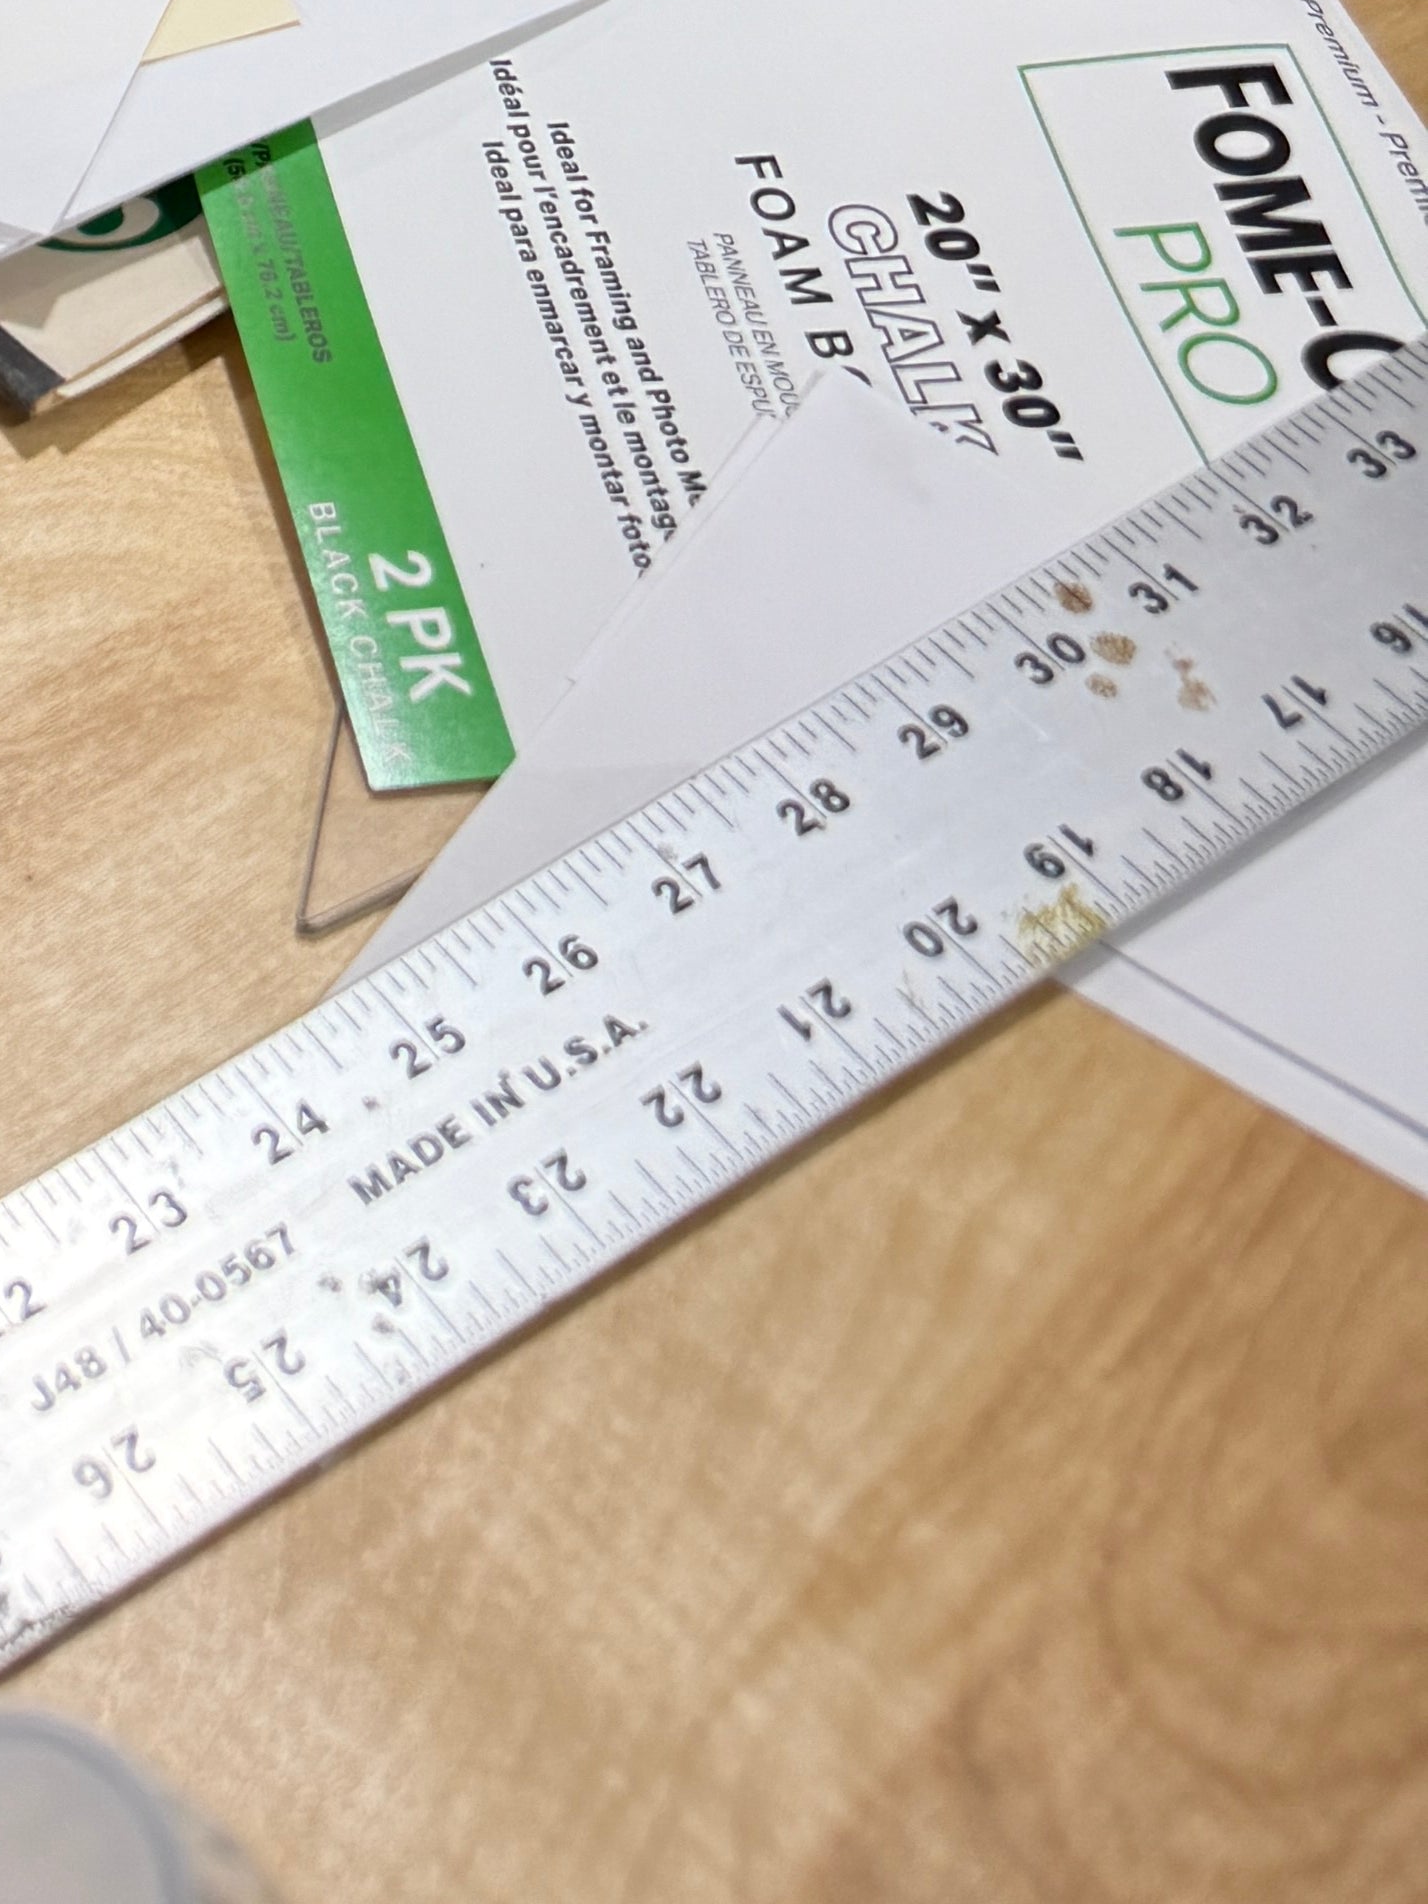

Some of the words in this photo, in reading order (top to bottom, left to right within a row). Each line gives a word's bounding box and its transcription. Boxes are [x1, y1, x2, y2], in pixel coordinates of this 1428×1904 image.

[490, 59, 519, 118] Idéal
[483, 141, 522, 204] Ideal
[507, 121, 546, 182] pour
[499, 206, 536, 264] para
[733, 153, 834, 306] FOAM
[532, 186, 616, 373] l'encadrement
[547, 122, 587, 186] Ideal
[571, 185, 598, 225] for
[585, 230, 638, 334] Framing
[627, 334, 660, 383] and
[646, 386, 690, 466] Photo
[686, 238, 738, 326] TABLERO
[721, 329, 750, 366] DE
[713, 231, 768, 325] PANNEAU
[752, 327, 776, 360] EN
[1113, 222, 1278, 406] PRO
[526, 266, 584, 389] enmarcar
[827, 202, 999, 457] CHALK
[905, 189, 1002, 294] 20"
[983, 357, 1084, 462] 30"
[603, 370, 626, 399] et
[614, 400, 636, 425] le
[580, 412, 629, 509] montar
[366, 548, 433, 592] 2
[617, 512, 653, 579] foto
[306, 501, 368, 621] BLACK
[348, 633, 415, 764] CHALK
[385, 605, 472, 703] PK
[1260, 674, 1329, 731] 17
[1140, 747, 1213, 802] 18
[106, 1190, 190, 1256] 23
[250, 1101, 330, 1167] 24
[388, 1017, 466, 1080] 25
[521, 932, 601, 997] 26
[653, 853, 723, 913] 27
[776, 775, 851, 838] 28
[896, 703, 972, 763] 29
[1014, 632, 1085, 685] 30
[1128, 563, 1199, 615] 31
[1239, 494, 1314, 546] 32
[1346, 430, 1417, 480] 33
[1023, 823, 1095, 879] 19
[900, 897, 980, 959] 20
[776, 978, 854, 1046] 21
[640, 1062, 725, 1130] 22
[506, 1148, 589, 1219] 23
[27, 1343, 110, 1417] J48
[345, 1116, 469, 1209] MADE
[476, 1077, 518, 1129] IN
[221, 1333, 308, 1407] 25
[70, 1426, 156, 1504] 26
